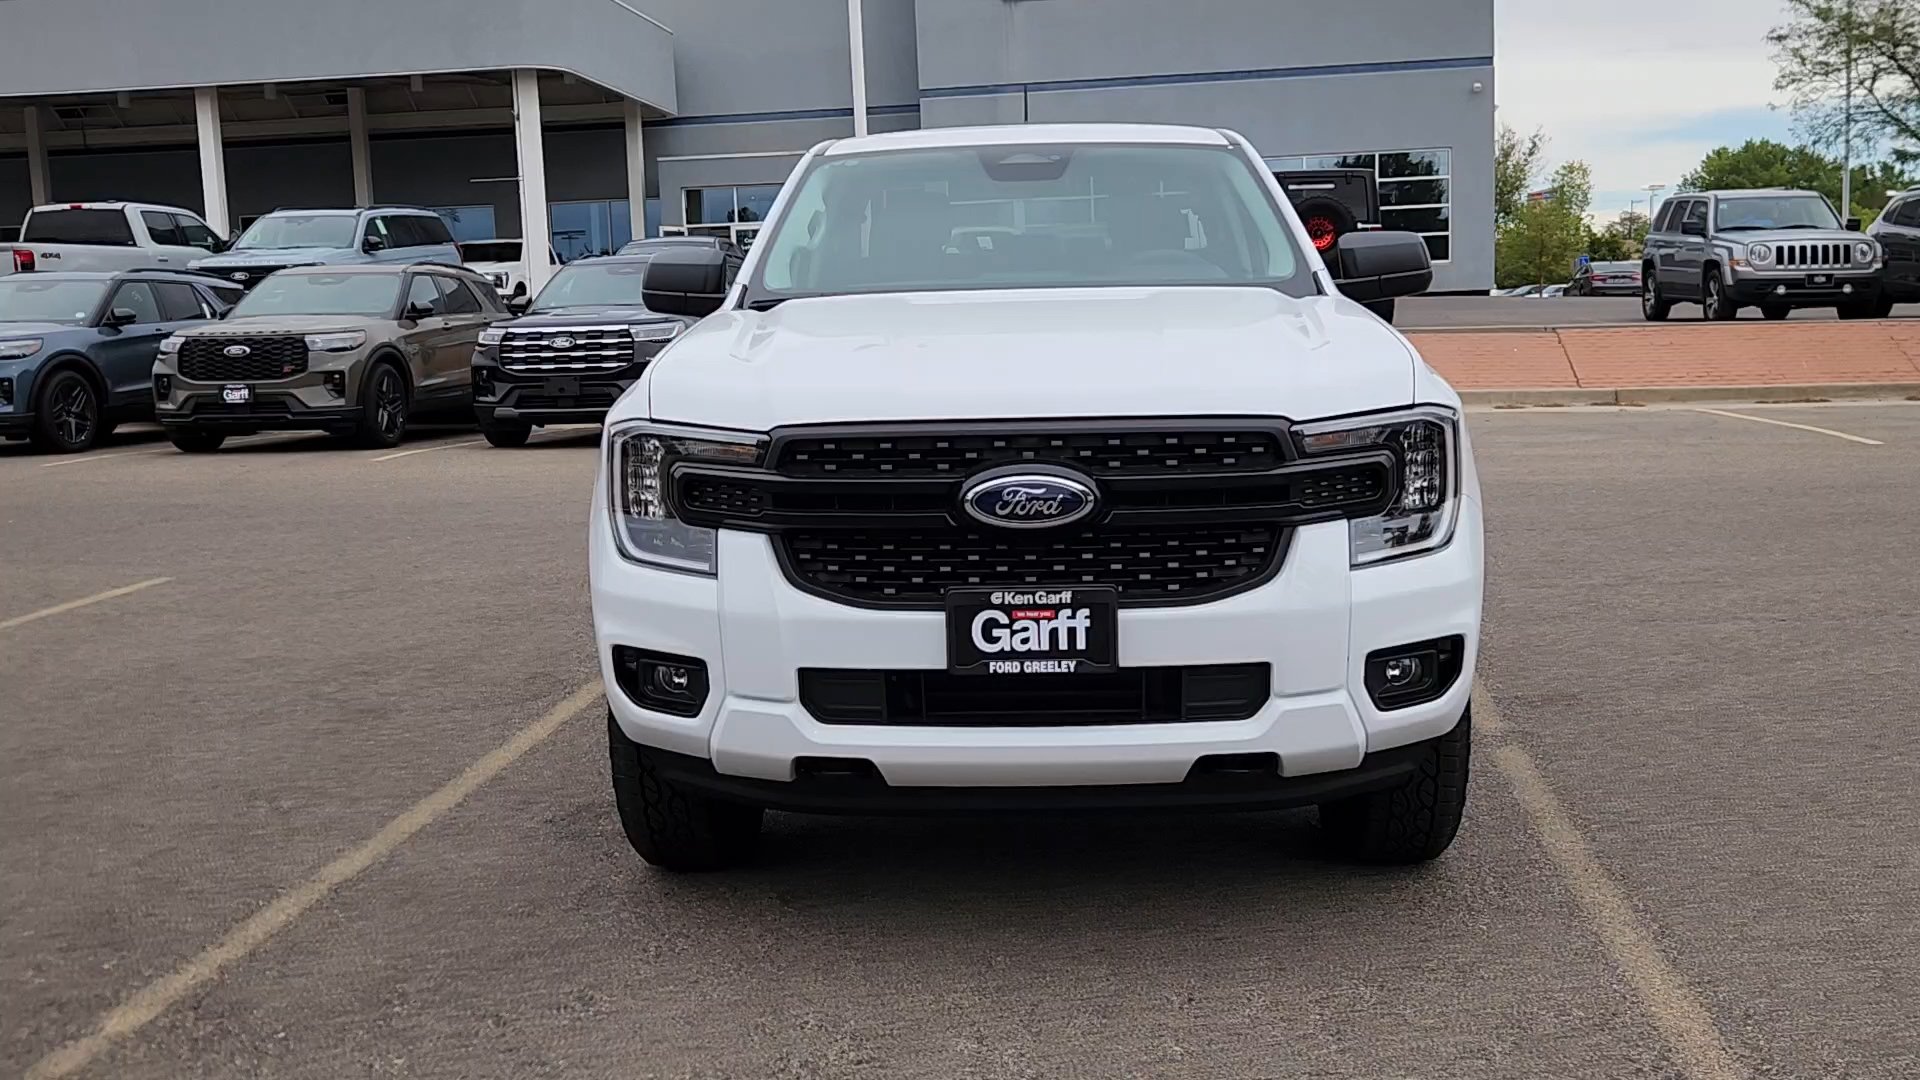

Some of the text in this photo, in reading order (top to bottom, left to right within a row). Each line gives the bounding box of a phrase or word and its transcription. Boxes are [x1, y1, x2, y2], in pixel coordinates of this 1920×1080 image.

[223, 389, 249, 400] Garff
[996, 486, 1063, 516] Ford
[1004, 591, 1072, 604] Ken Garff
[971, 608, 1091, 653] Garff
[989, 660, 1077, 674] FORD GREELEY
